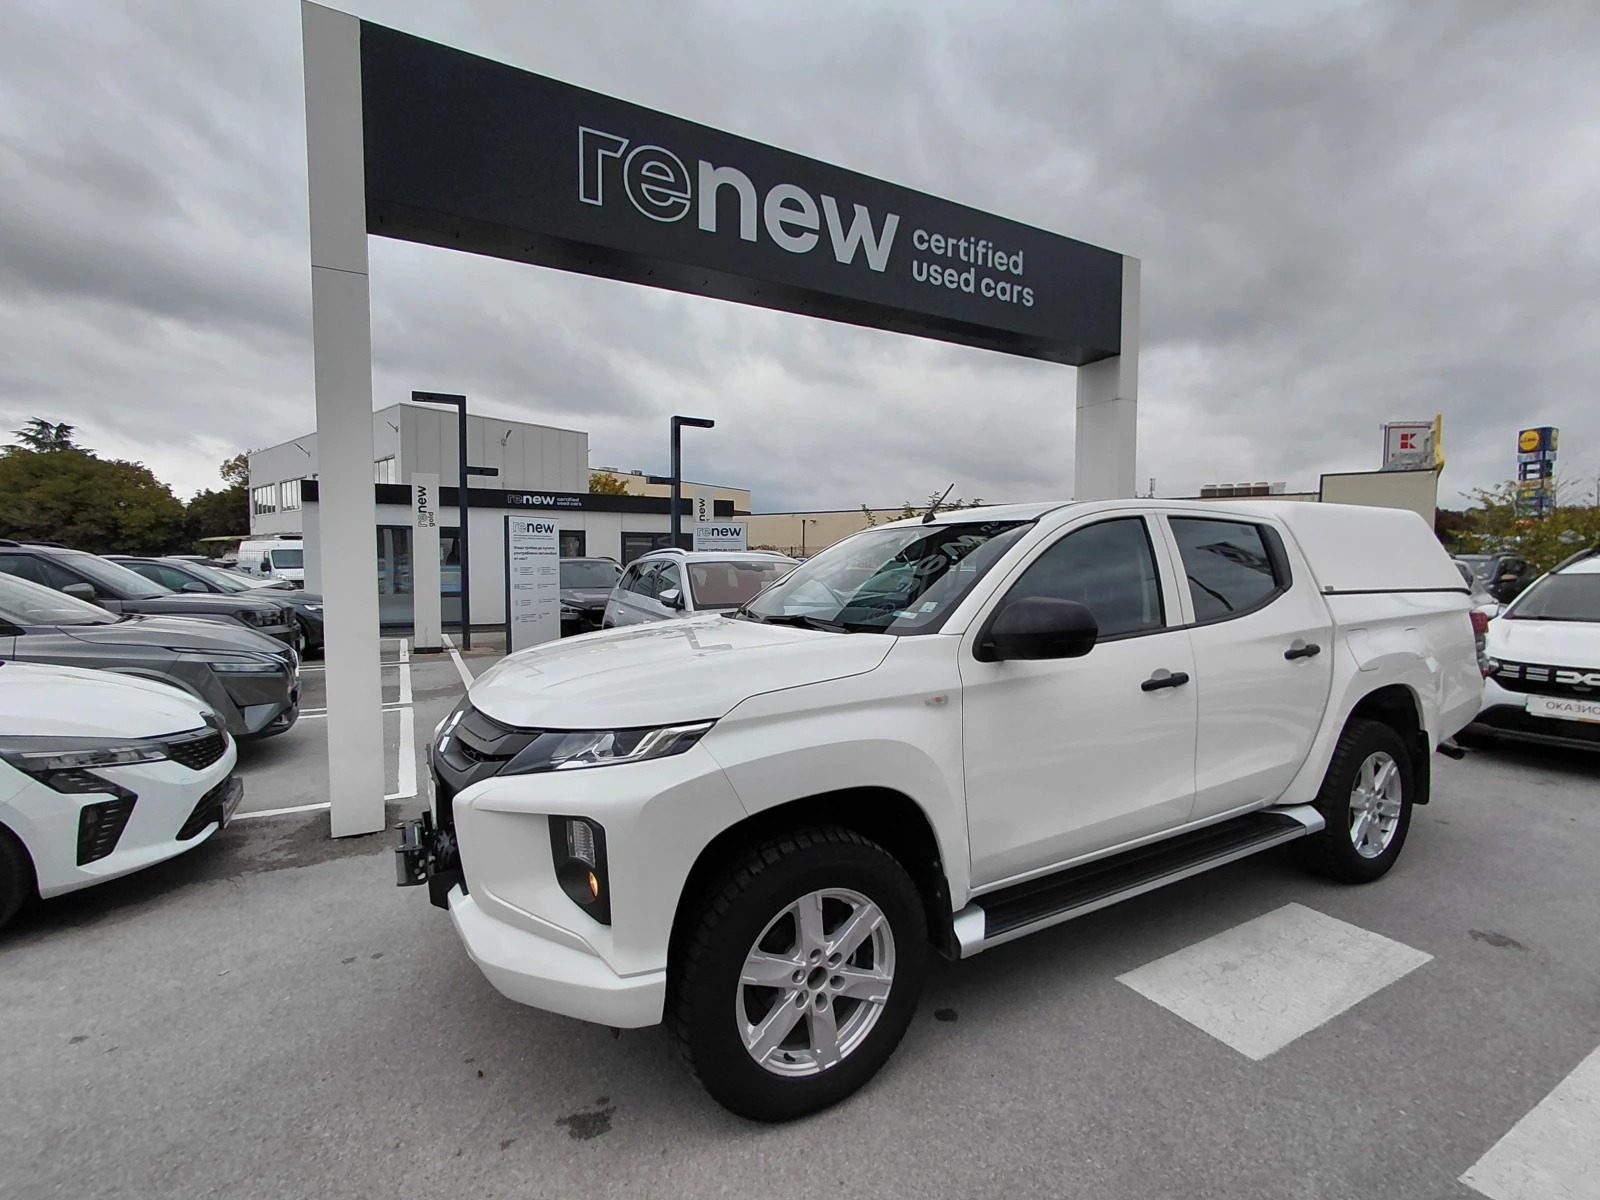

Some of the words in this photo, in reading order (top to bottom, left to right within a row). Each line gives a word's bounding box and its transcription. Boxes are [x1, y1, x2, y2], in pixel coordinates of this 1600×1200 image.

[578, 125, 900, 273] renew
[912, 229, 1024, 276] certified
[912, 259, 975, 294] used
[980, 277, 1035, 307] cars
[417, 485, 428, 528] renew
[507, 494, 555, 505] renew
[698, 498, 706, 522] new
[427, 511, 436, 528] gold
[512, 521, 555, 534] renew
[696, 527, 742, 537] renew
